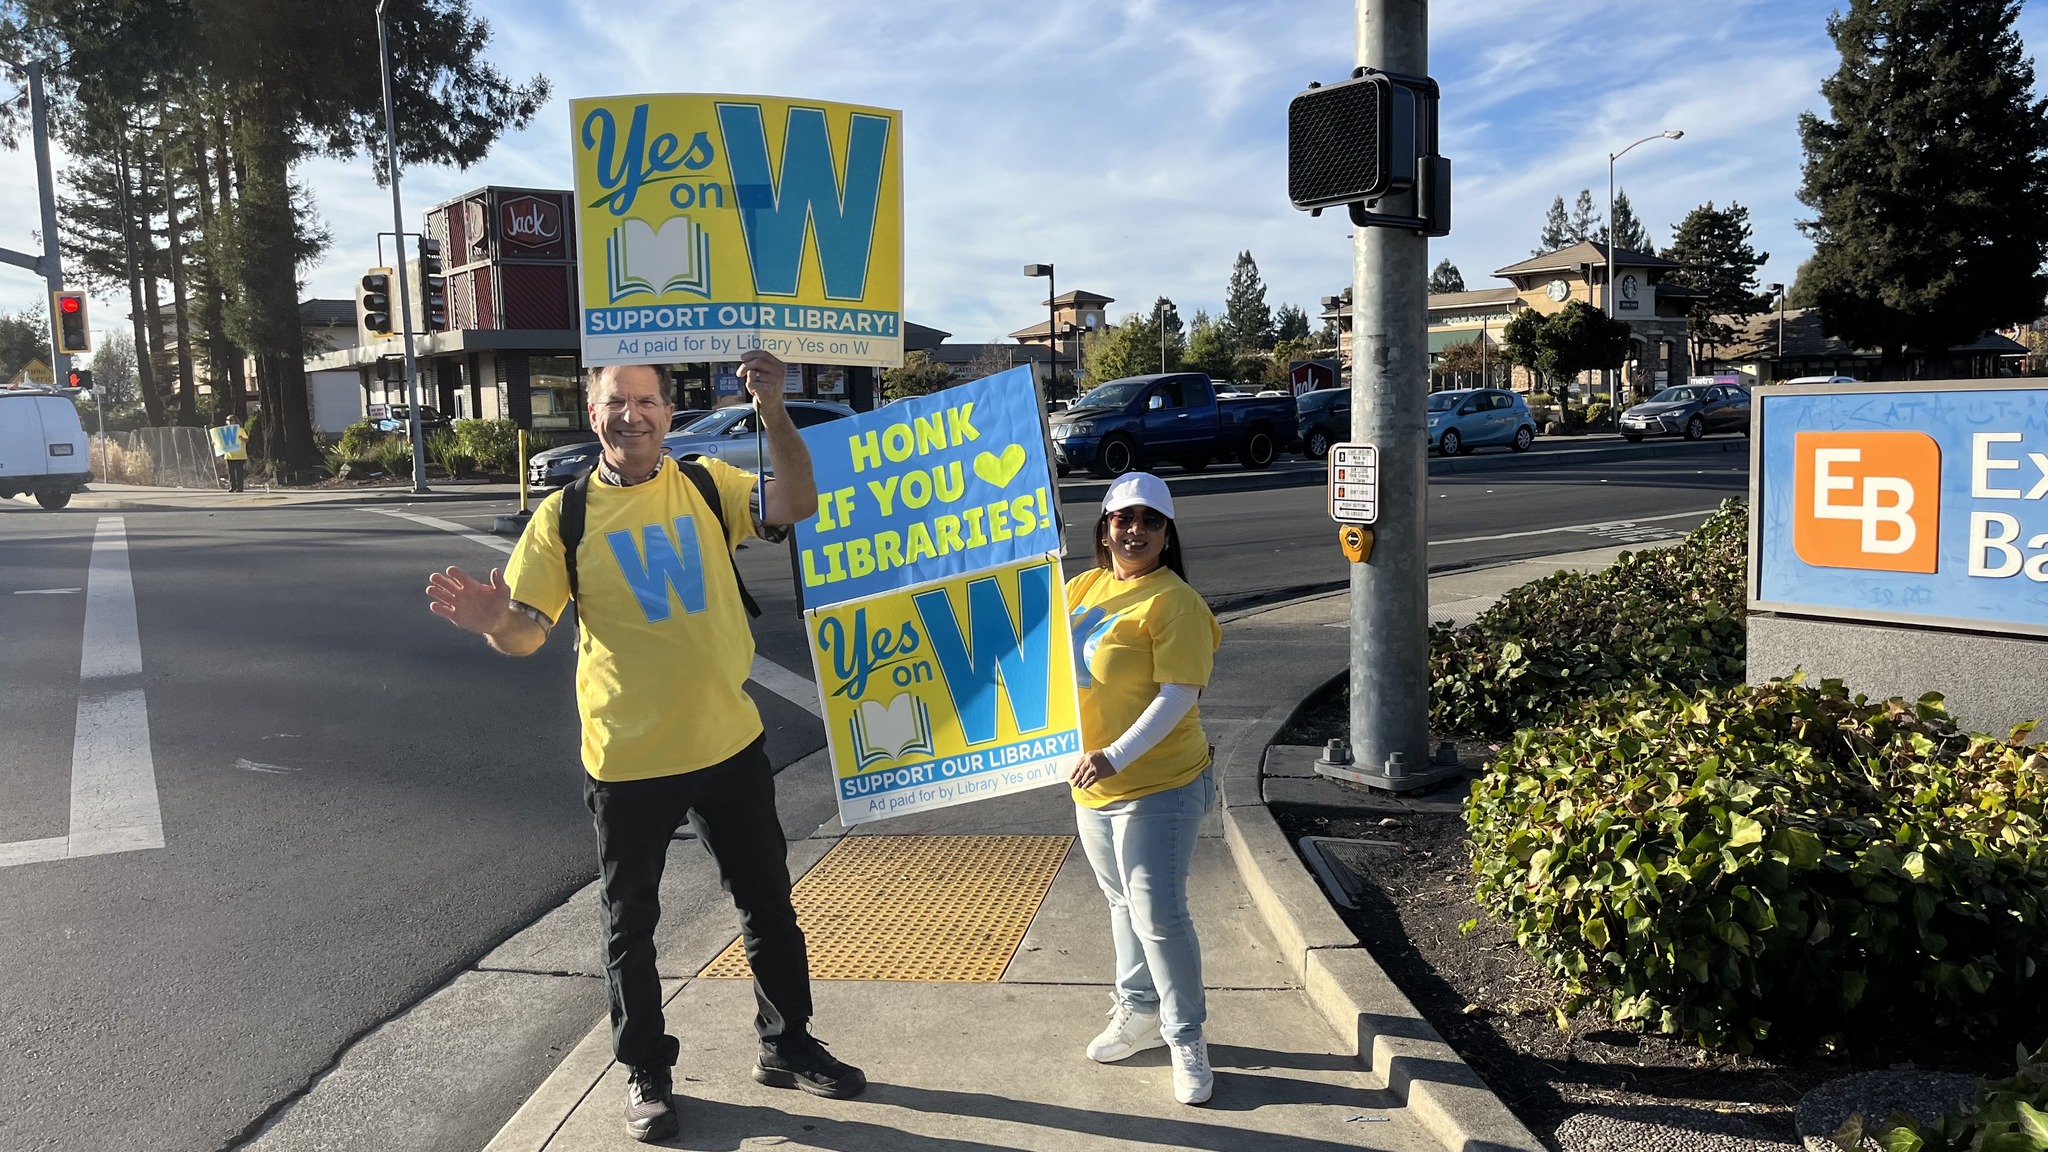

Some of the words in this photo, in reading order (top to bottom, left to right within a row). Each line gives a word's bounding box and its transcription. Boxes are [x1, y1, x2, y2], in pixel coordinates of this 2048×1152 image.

[582, 103, 715, 216] Yes
[507, 203, 558, 237] Jack
[669, 182, 723, 209] on
[713, 101, 892, 302] W
[591, 307, 709, 331] SUPPORT
[718, 306, 776, 327] OUR
[784, 308, 895, 333] LIBRARY!
[617, 339, 639, 354] Ad
[644, 337, 678, 356] paid
[683, 336, 706, 351] for
[711, 335, 731, 353] by
[737, 335, 792, 354] Library
[797, 337, 825, 353] Yes
[829, 342, 848, 354] on
[853, 340, 869, 355] W
[1690, 377, 1714, 385] metro
[219, 425, 239, 447] W
[848, 402, 982, 473] HONK
[814, 486, 856, 533] IF
[867, 460, 966, 517] YOU
[604, 514, 708, 624] W
[802, 487, 1052, 588] LIBRARIES!
[1968, 511, 2048, 583] Ba
[818, 607, 920, 700] Yes
[892, 660, 933, 687] on
[911, 563, 1052, 747] W
[845, 764, 935, 796] SUPPORT
[941, 754, 984, 777] OUR
[989, 732, 1076, 767] LIBRARY!
[869, 798, 886, 812] Ad
[889, 791, 916, 811] paid
[919, 788, 935, 802] for
[939, 785, 953, 800] by
[957, 777, 998, 795] Library
[1001, 771, 1024, 785] Yes
[1027, 768, 1041, 780] on
[1045, 761, 1058, 776] W
